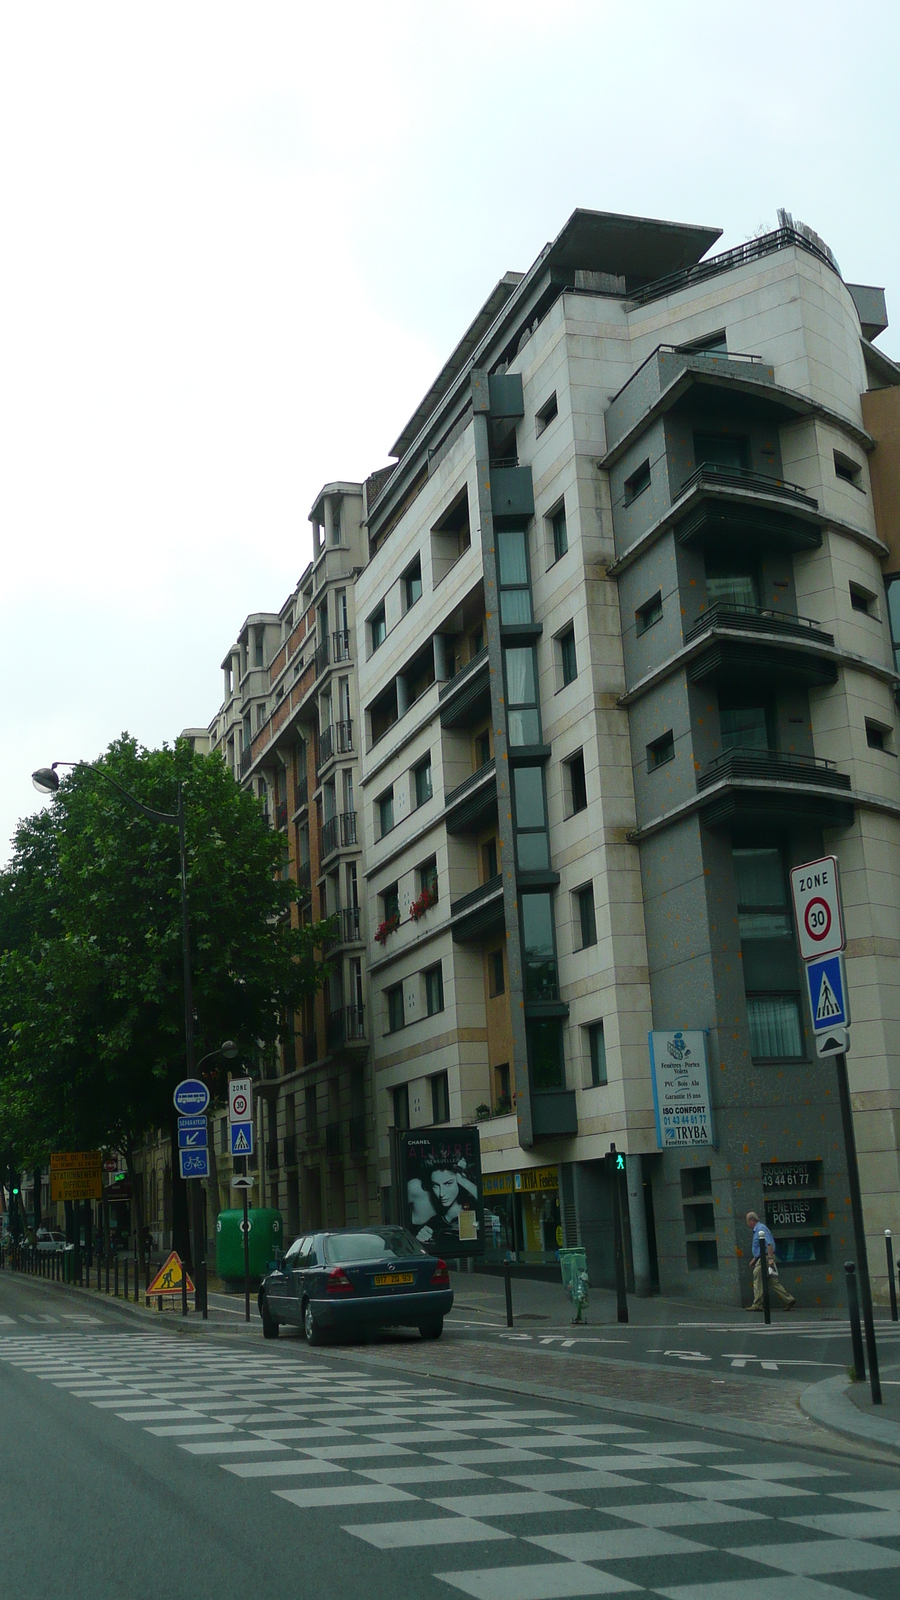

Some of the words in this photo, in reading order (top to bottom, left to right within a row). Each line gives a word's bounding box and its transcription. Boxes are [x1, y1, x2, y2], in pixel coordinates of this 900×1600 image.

[799, 871, 829, 892] ZONE
[810, 910, 825, 928] 30
[232, 1084, 247, 1092] ZONE
[236, 1101, 244, 1109] 30
[662, 1107, 674, 1115] ISO
[675, 1106, 706, 1114] CONFORT
[663, 1117, 671, 1125] 01
[672, 1116, 680, 1124] 43
[682, 1116, 689, 1124] 44
[691, 1115, 698, 1124] 61
[700, 1115, 707, 1123] 77
[676, 1125, 707, 1139] TRYBA
[408, 1143, 472, 1158] ALLURE
[52, 1170, 100, 1180] STATIONNEMENT
[521, 1171, 538, 1189] TRYBA
[762, 1175, 773, 1186] 43
[774, 1175, 786, 1186] 44
[787, 1174, 797, 1185] 61
[799, 1173, 809, 1184] 77
[63, 1180, 90, 1189] DIFFICILE
[773, 1212, 807, 1224] PORTES
[375, 1276, 387, 1284] 917
